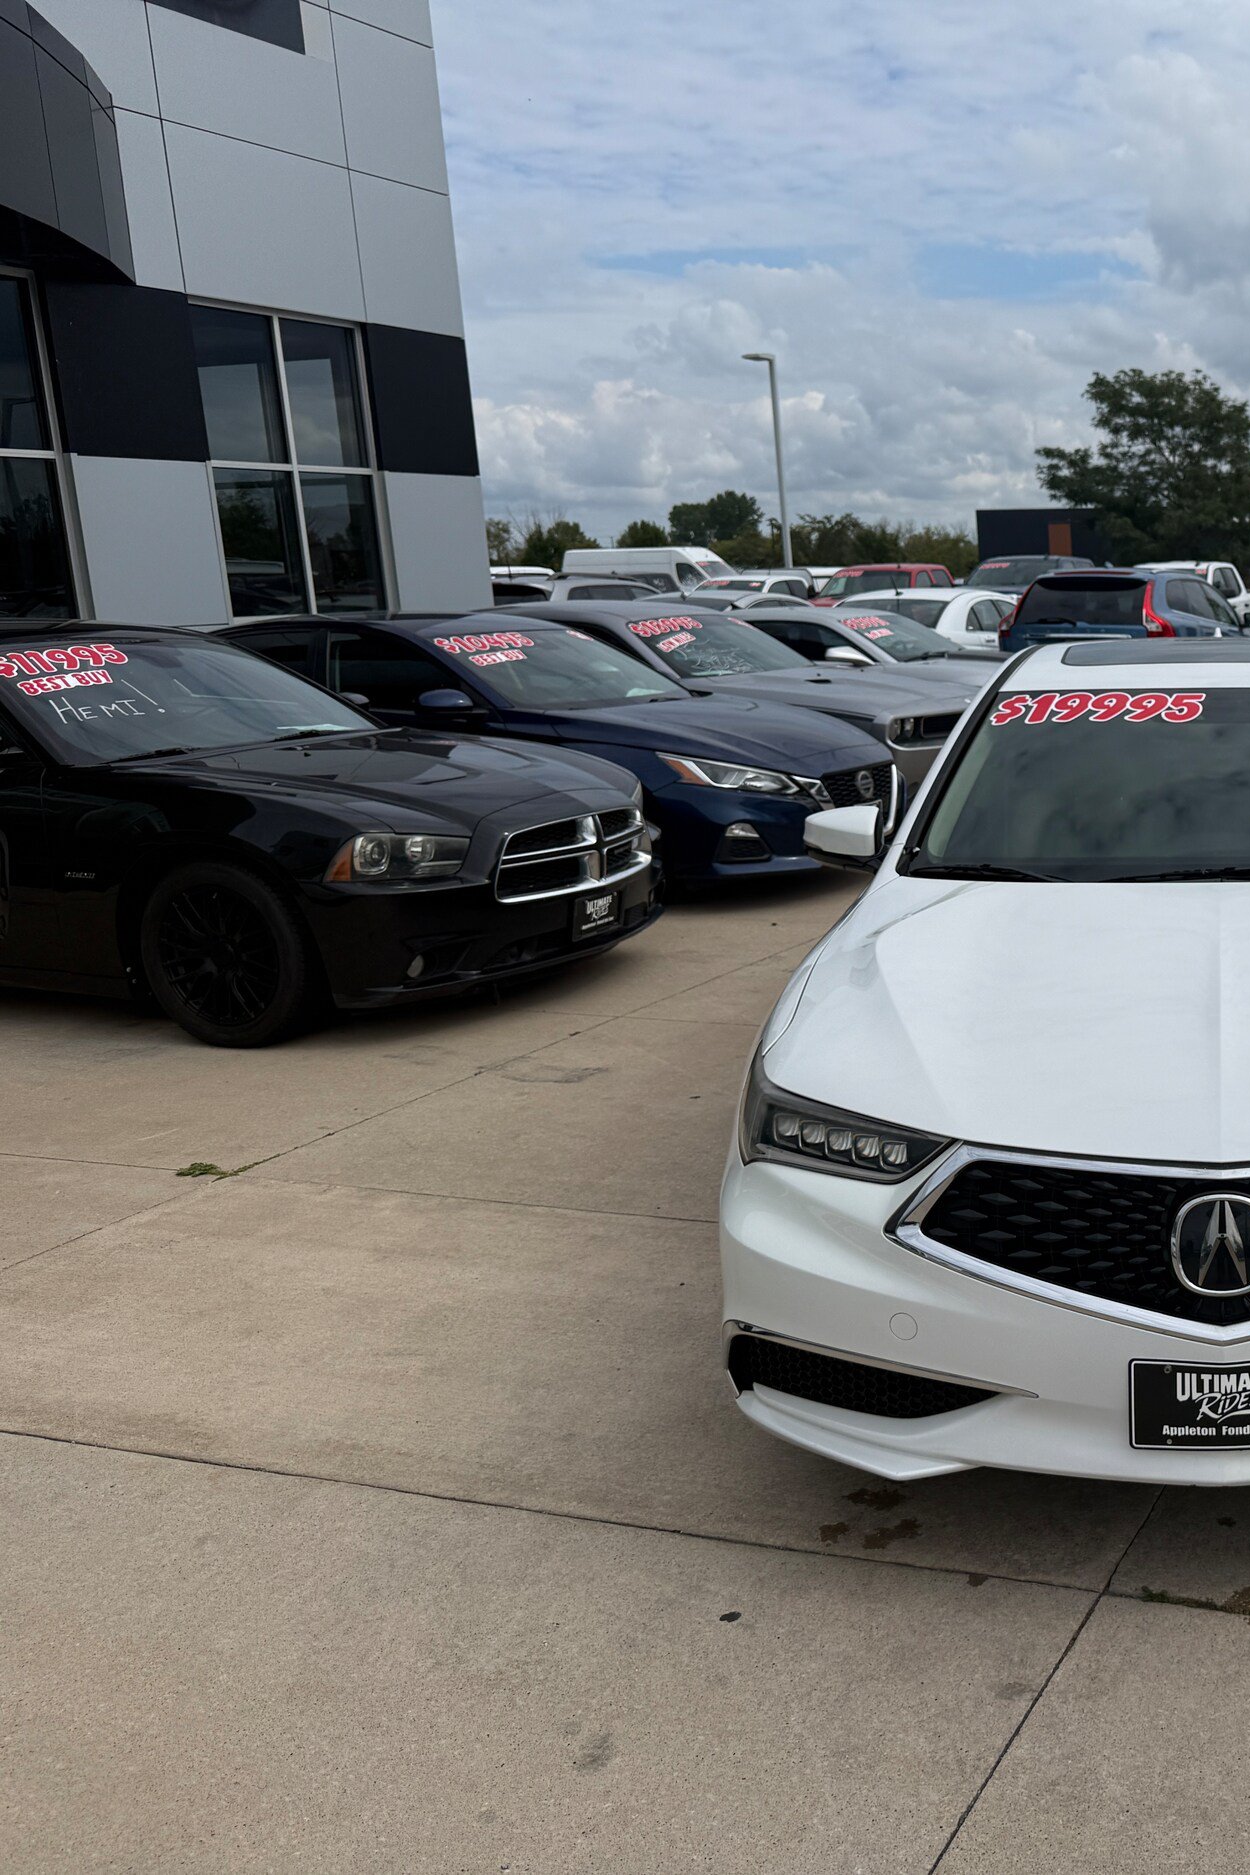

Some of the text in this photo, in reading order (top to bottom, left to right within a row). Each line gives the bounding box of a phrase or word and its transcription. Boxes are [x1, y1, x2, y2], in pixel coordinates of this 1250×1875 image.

[434, 631, 535, 654] $10495
[468, 648, 528, 667] BEST BUY
[17, 670, 113, 696] BEST BUY
[990, 691, 1207, 726] $19995
[1161, 1424, 1217, 1437] Appleton
[1221, 1424, 1250, 1436] Fond
